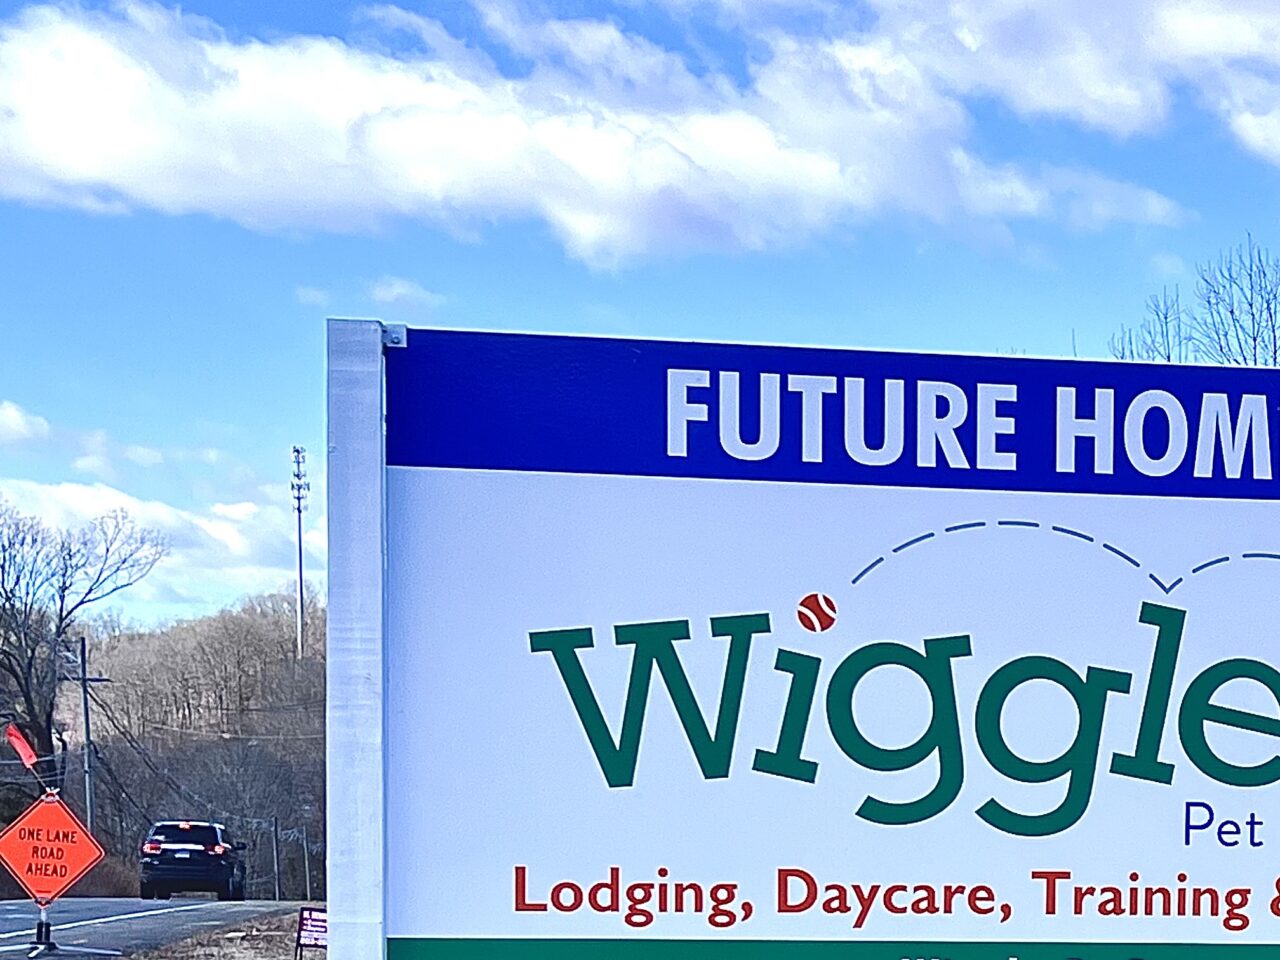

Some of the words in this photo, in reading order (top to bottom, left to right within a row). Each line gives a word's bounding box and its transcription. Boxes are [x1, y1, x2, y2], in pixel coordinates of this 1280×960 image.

[664, 368, 1018, 475] FUTURE
[18, 827, 43, 841] ONE
[46, 828, 78, 844] LANE
[1184, 801, 1264, 848] Pet
[31, 845, 65, 860] ROAD
[25, 862, 68, 878] AHEAD
[516, 868, 752, 925] Lodging,
[777, 868, 1010, 927] Daycare,
[1033, 872, 1250, 930] Training
